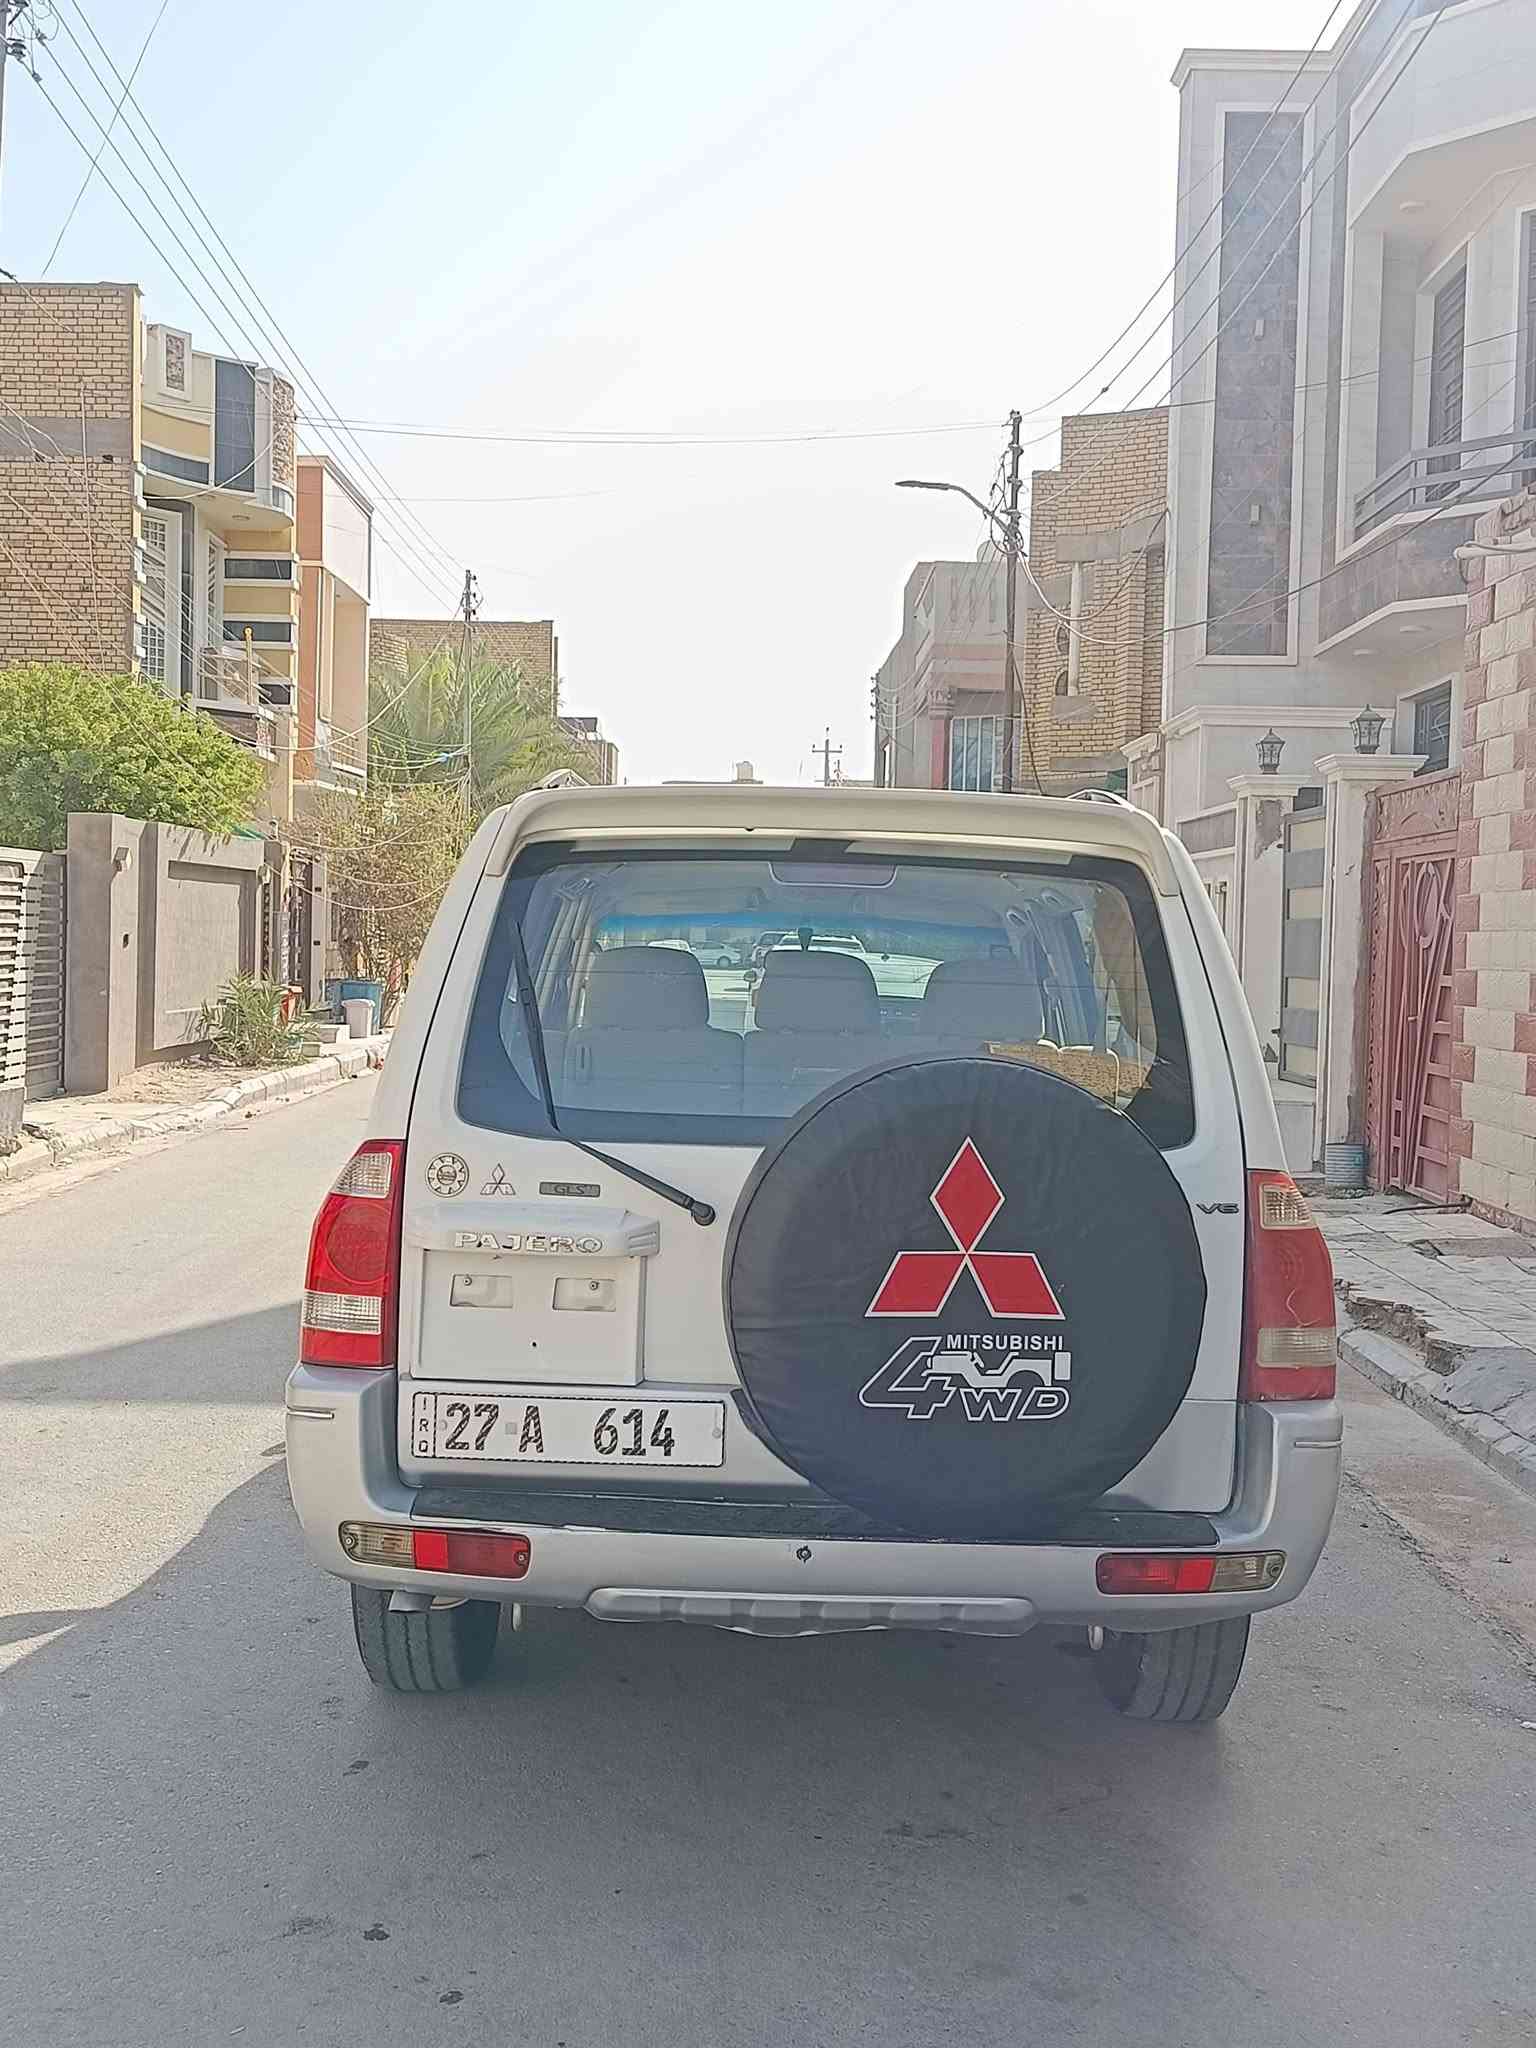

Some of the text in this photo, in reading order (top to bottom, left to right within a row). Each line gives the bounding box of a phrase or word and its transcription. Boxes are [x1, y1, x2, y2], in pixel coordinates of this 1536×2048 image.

[554, 1184, 586, 1196] GLS
[1196, 1202, 1240, 1215] V6
[454, 1232, 603, 1254] PAJERO
[946, 1334, 1064, 1351] MITSUBISHI
[858, 1335, 1070, 1422] 4WD
[445, 1402, 676, 1457] 27 A 614
